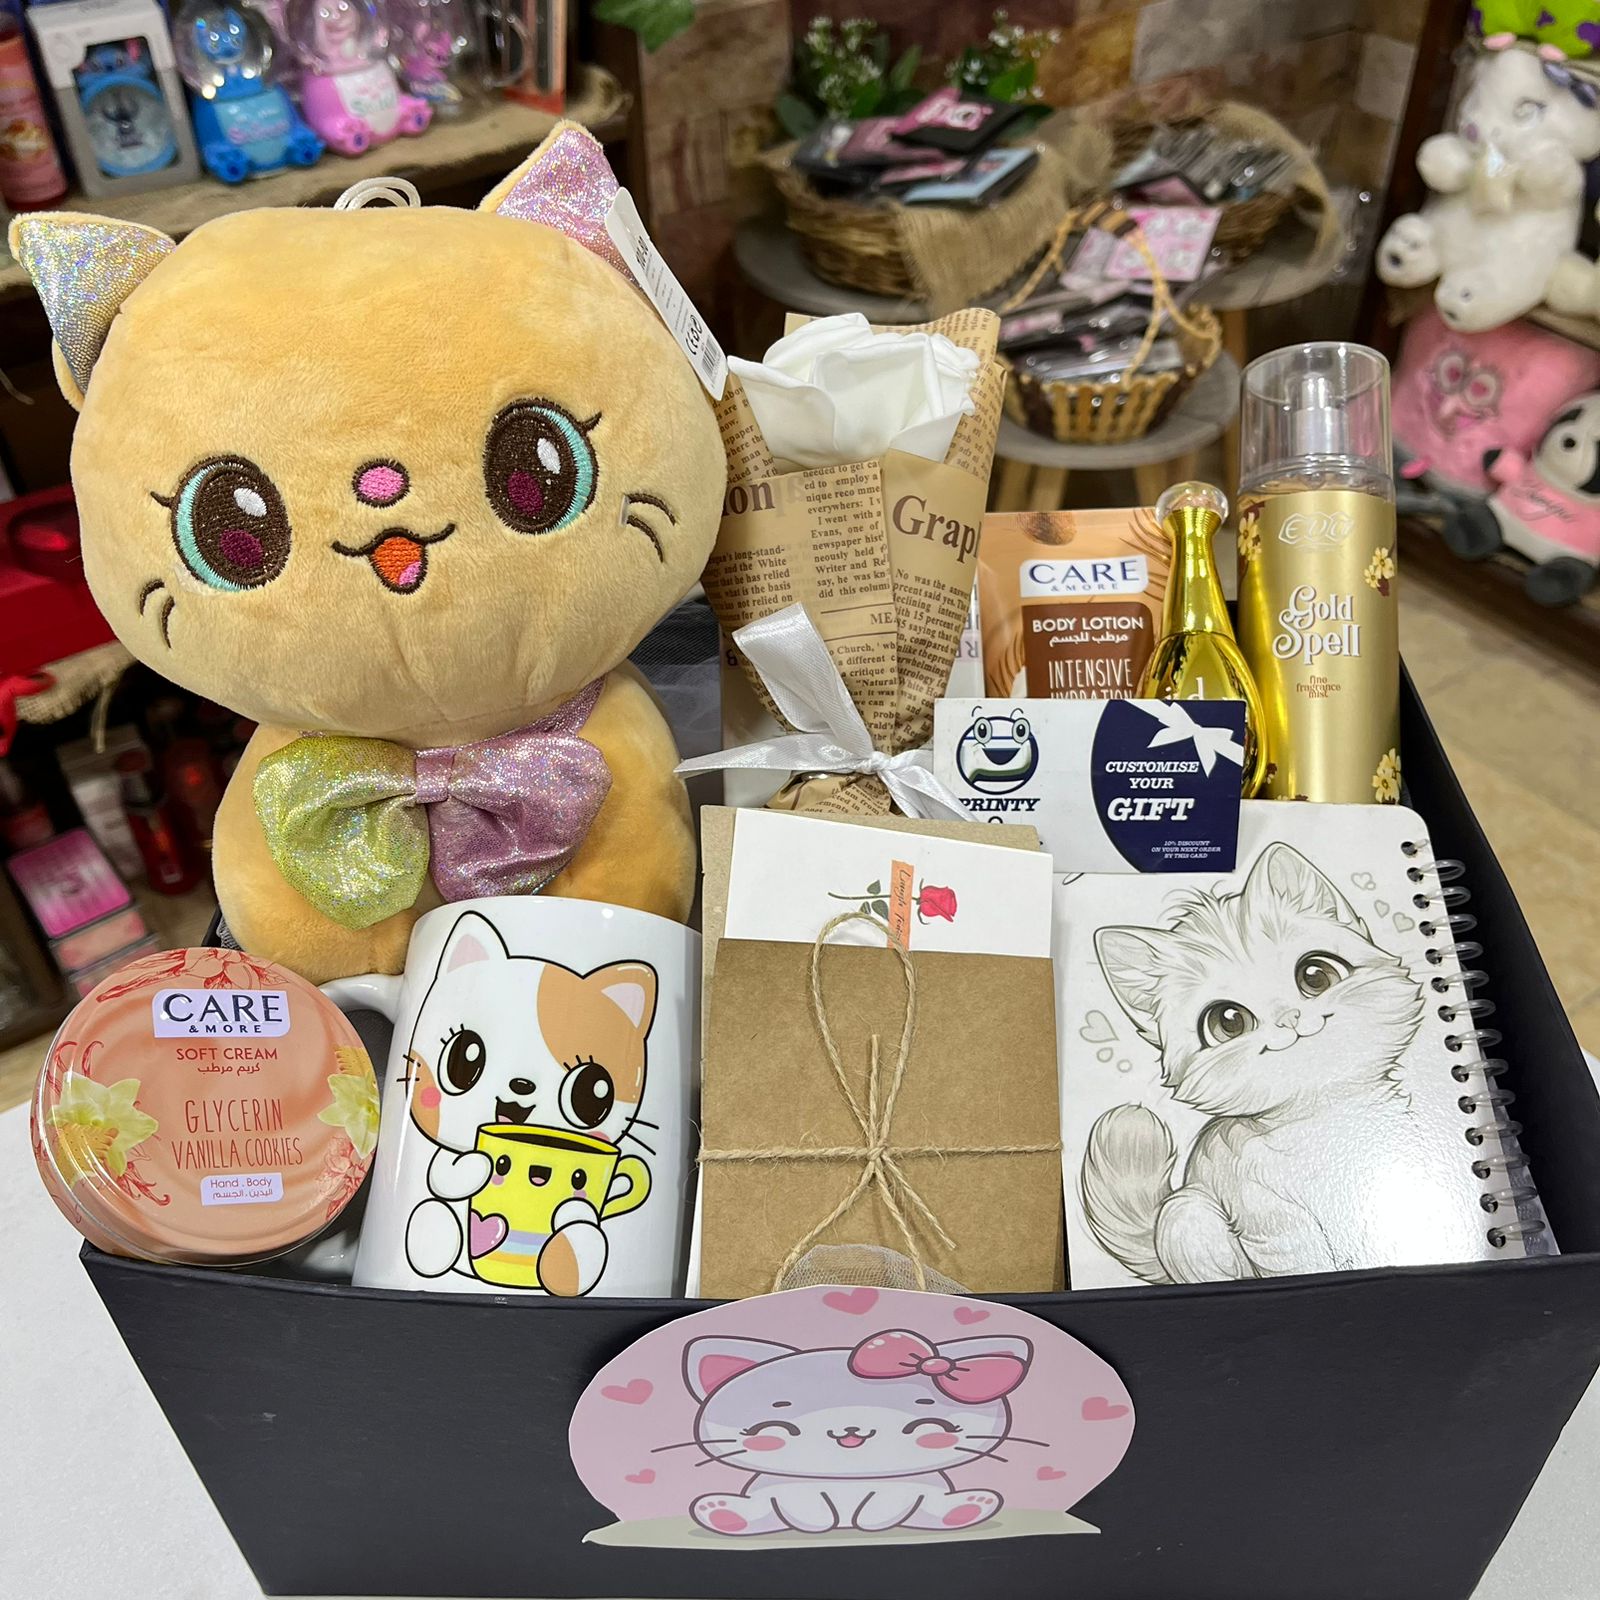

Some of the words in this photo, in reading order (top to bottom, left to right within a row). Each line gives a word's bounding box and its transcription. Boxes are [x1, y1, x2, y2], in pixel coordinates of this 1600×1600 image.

[724, 403, 738, 414] are
[724, 424, 754, 445] spaper
[741, 450, 761, 464] man
[727, 466, 752, 485] icked
[753, 464, 760, 472] a
[838, 464, 848, 473] to
[804, 482, 816, 490] ed
[818, 480, 828, 488] to
[836, 474, 870, 487] employ
[806, 492, 832, 504] nique
[834, 490, 855, 499] reco
[818, 516, 822, 526] I
[825, 514, 848, 525] went
[852, 509, 874, 520] with
[811, 528, 843, 540] Evans,
[847, 525, 865, 534] one
[869, 520, 880, 531] of
[892, 494, 982, 564] Grap
[812, 536, 862, 552] newspaper
[735, 546, 786, 562] long-stand-
[814, 550, 849, 564] neously
[854, 548, 874, 558] held
[740, 562, 753, 572] the
[758, 558, 787, 570] White
[816, 563, 847, 575] Writer
[850, 562, 868, 571] and
[872, 558, 886, 568] Re
[1030, 560, 1140, 584] CARE
[746, 573, 761, 584] has
[764, 568, 790, 580] relied
[816, 577, 835, 588] say,
[837, 575, 848, 584] he
[854, 573, 870, 582] was
[874, 569, 886, 579] kn
[896, 568, 909, 580] No
[914, 575, 931, 586] was
[933, 577, 946, 591] the
[751, 585, 766, 594] the
[768, 582, 792, 592] basis
[818, 589, 834, 600] did
[840, 586, 856, 596] this
[1066, 583, 1118, 591] MORE
[752, 596, 779, 608] relied
[781, 594, 794, 602] on
[924, 588, 941, 602] said
[1289, 584, 1354, 630] Gold
[870, 612, 898, 626] ME
[896, 607, 910, 619] ith
[914, 609, 924, 621] 15
[925, 614, 956, 632] percent
[1032, 618, 1077, 632] BODY
[1082, 616, 1144, 630] LOTION
[908, 620, 936, 638] saying
[1049, 632, 1089, 648] للجسم
[1092, 631, 1128, 644] مرطب
[1272, 608, 1362, 666] Spell
[882, 642, 896, 650] wh
[896, 644, 918, 655] nlike
[910, 636, 949, 654] compared
[846, 655, 886, 666] different
[850, 668, 885, 681] critique
[897, 668, 936, 686] strology
[1048, 658, 1134, 689] INTENSIVE
[1310, 675, 1328, 684] fine
[926, 687, 944, 698] Ho
[1296, 683, 1341, 692] fragrance
[1308, 690, 1328, 698] mist
[874, 710, 895, 720] prob
[906, 705, 922, 716] and
[868, 722, 894, 730] rald's
[1105, 761, 1200, 773] CUSTOMISE
[1130, 778, 1174, 789] YOUR
[958, 798, 1040, 812] PRINTY
[1107, 798, 1195, 821] GIFT
[894, 869, 912, 908] Laugh
[162, 993, 282, 1022] CARE
[188, 1024, 199, 1033] &
[206, 1024, 262, 1033] MORE
[176, 1048, 218, 1060] SOFT
[223, 1048, 278, 1060] CREAM
[197, 1063, 232, 1075] مرطب
[236, 1062, 260, 1076] كريم
[185, 1098, 283, 1134] GLYCERIN
[172, 1139, 242, 1170] VANILLA
[245, 1137, 304, 1167] COOKIES
[210, 1178, 239, 1188] Hand
[246, 1177, 272, 1187] Body
